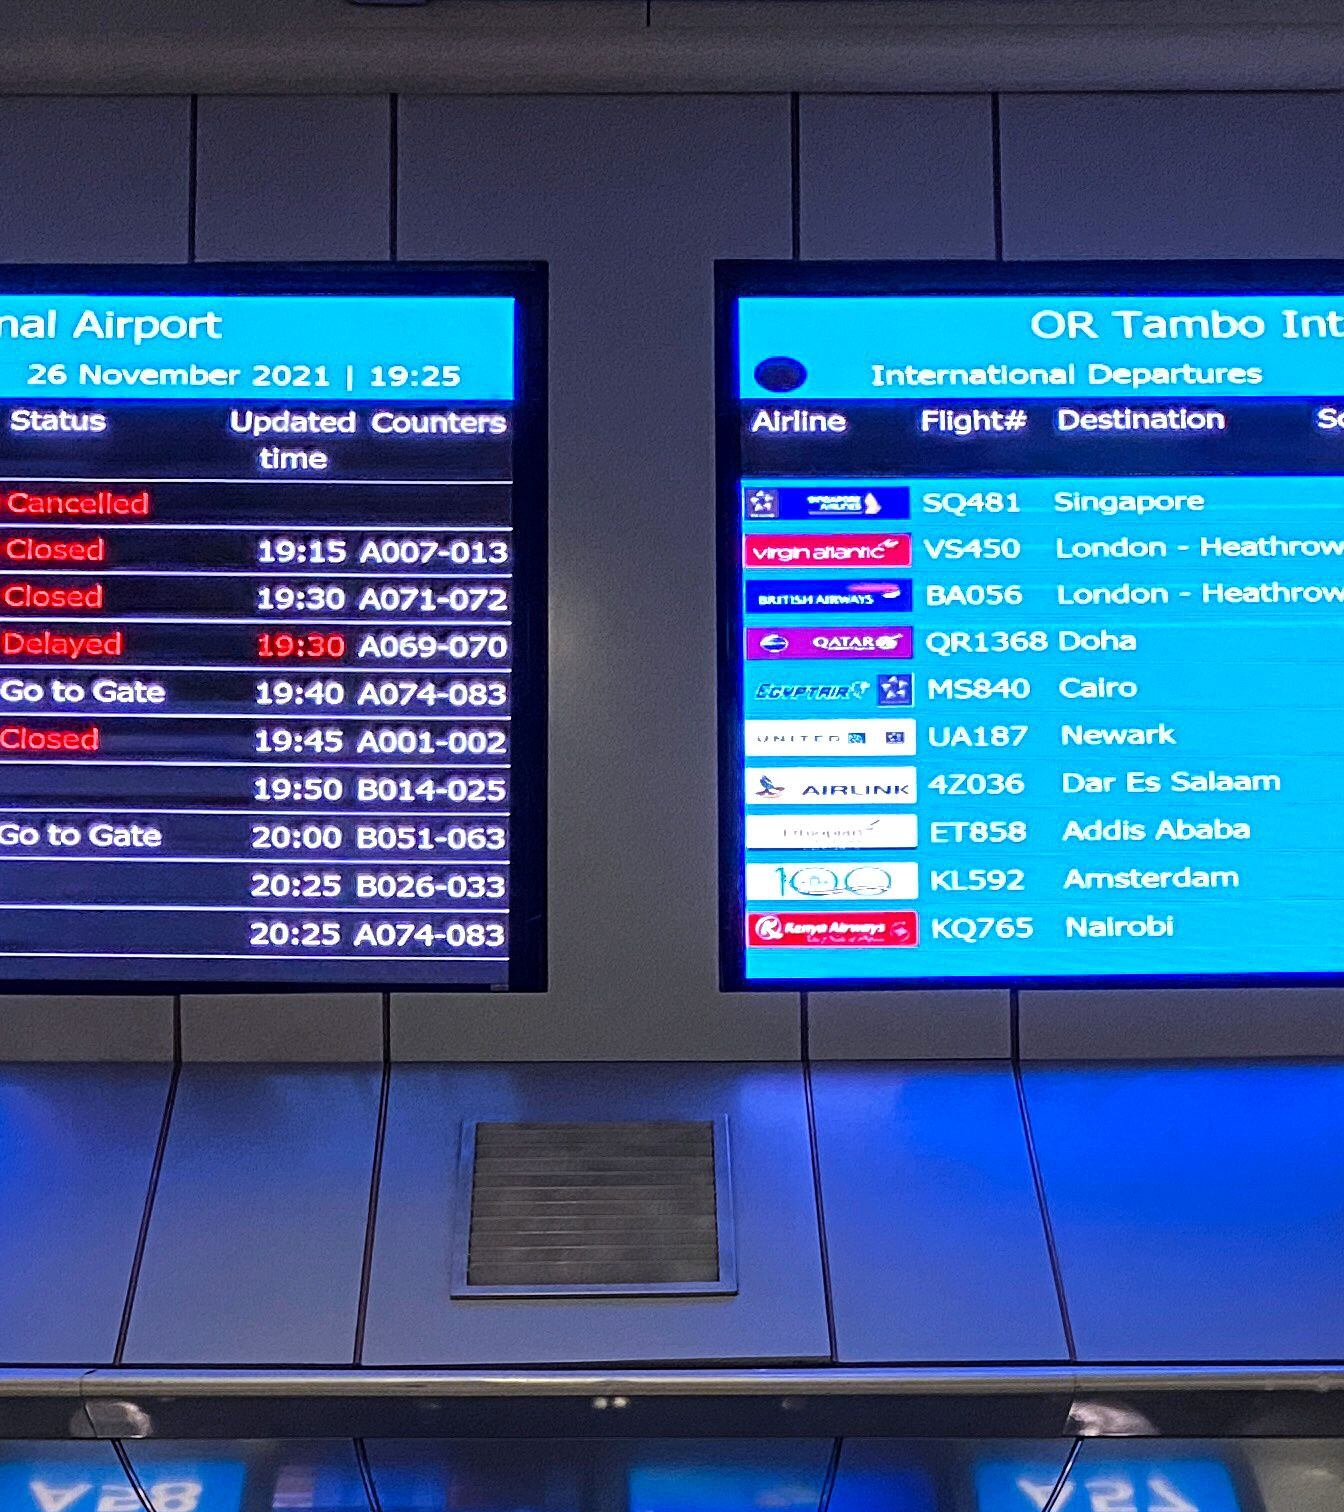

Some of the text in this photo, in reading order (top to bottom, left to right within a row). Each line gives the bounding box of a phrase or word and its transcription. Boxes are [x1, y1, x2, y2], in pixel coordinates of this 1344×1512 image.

[73, 310, 222, 344] Airport
[28, 364, 460, 386] 26 November 2021 19:25
[11, 409, 106, 432] Status
[231, 410, 356, 436] Updated
[372, 411, 507, 434] Counters
[259, 447, 328, 469] time
[7, 492, 150, 515] Cancelled
[924, 492, 1204, 516] SQ481 Singapore
[6, 538, 105, 562] Closed
[924, 539, 1020, 558] VS450
[1057, 538, 1166, 558] London
[4, 585, 103, 609] Closed
[927, 585, 1022, 605] BA056
[1058, 584, 1168, 604] London
[3, 631, 123, 659] Delayed
[926, 630, 1136, 656] QR1368 Doha
[0, 681, 45, 704] Go
[54, 682, 83, 704] to
[92, 681, 166, 705] Gate
[929, 678, 1136, 699] MS840 Cairo
[0, 728, 100, 752] Closed
[929, 724, 1175, 746] UA187 Newark
[802, 771, 1280, 795] AIRLINK 4Z036 Dar Es Salaam
[47, 826, 78, 848] to
[89, 825, 163, 849] Gate
[931, 819, 1250, 842] ET858 Addis Ababa
[931, 867, 1238, 890] KL592 Amsterdam
[932, 916, 1173, 942] KQ765 Nairobi
